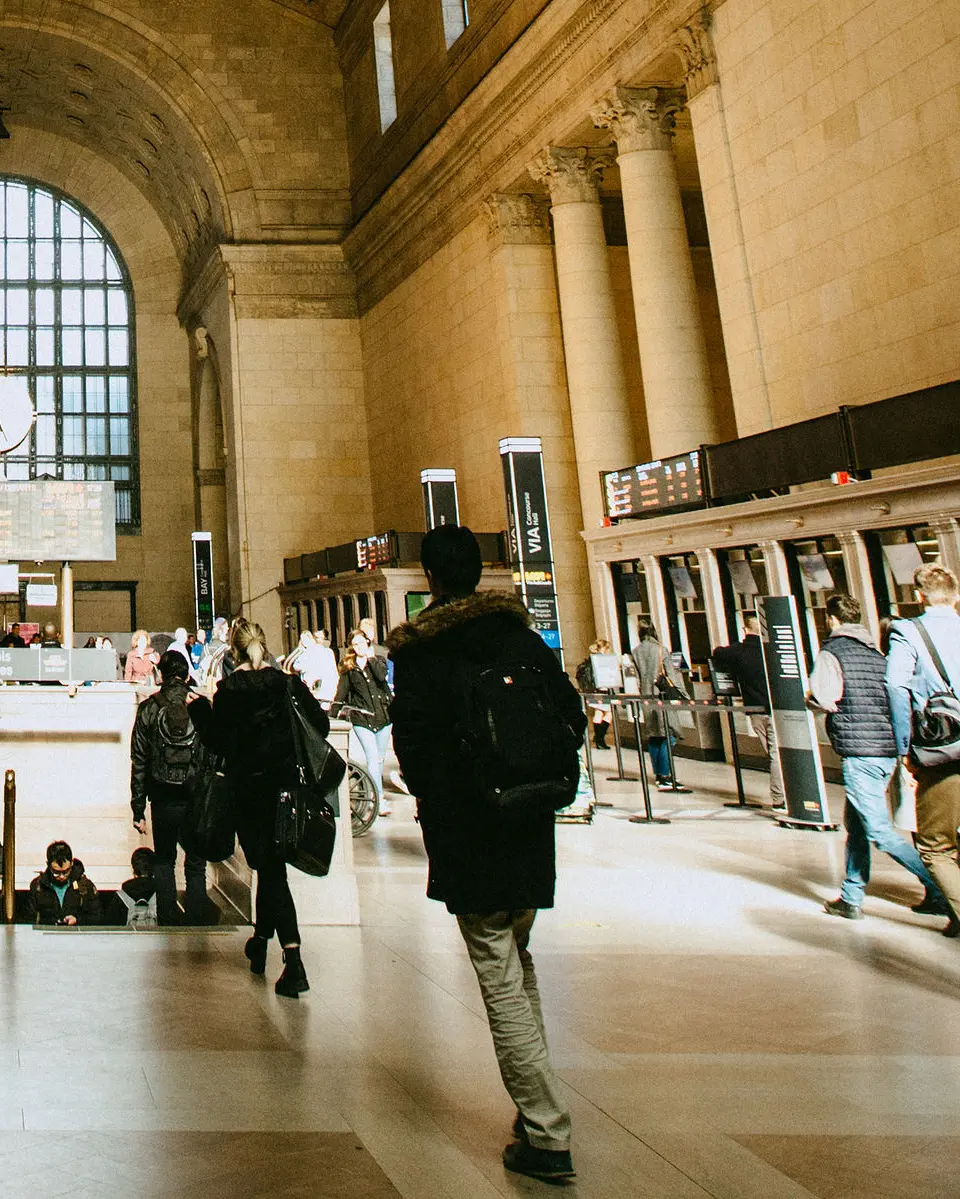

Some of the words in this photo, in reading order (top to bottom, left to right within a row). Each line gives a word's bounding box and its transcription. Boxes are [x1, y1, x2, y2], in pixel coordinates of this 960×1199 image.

[524, 491, 532, 525] Concourse
[526, 527, 542, 554] VIA
[200, 577, 208, 595] BAY
